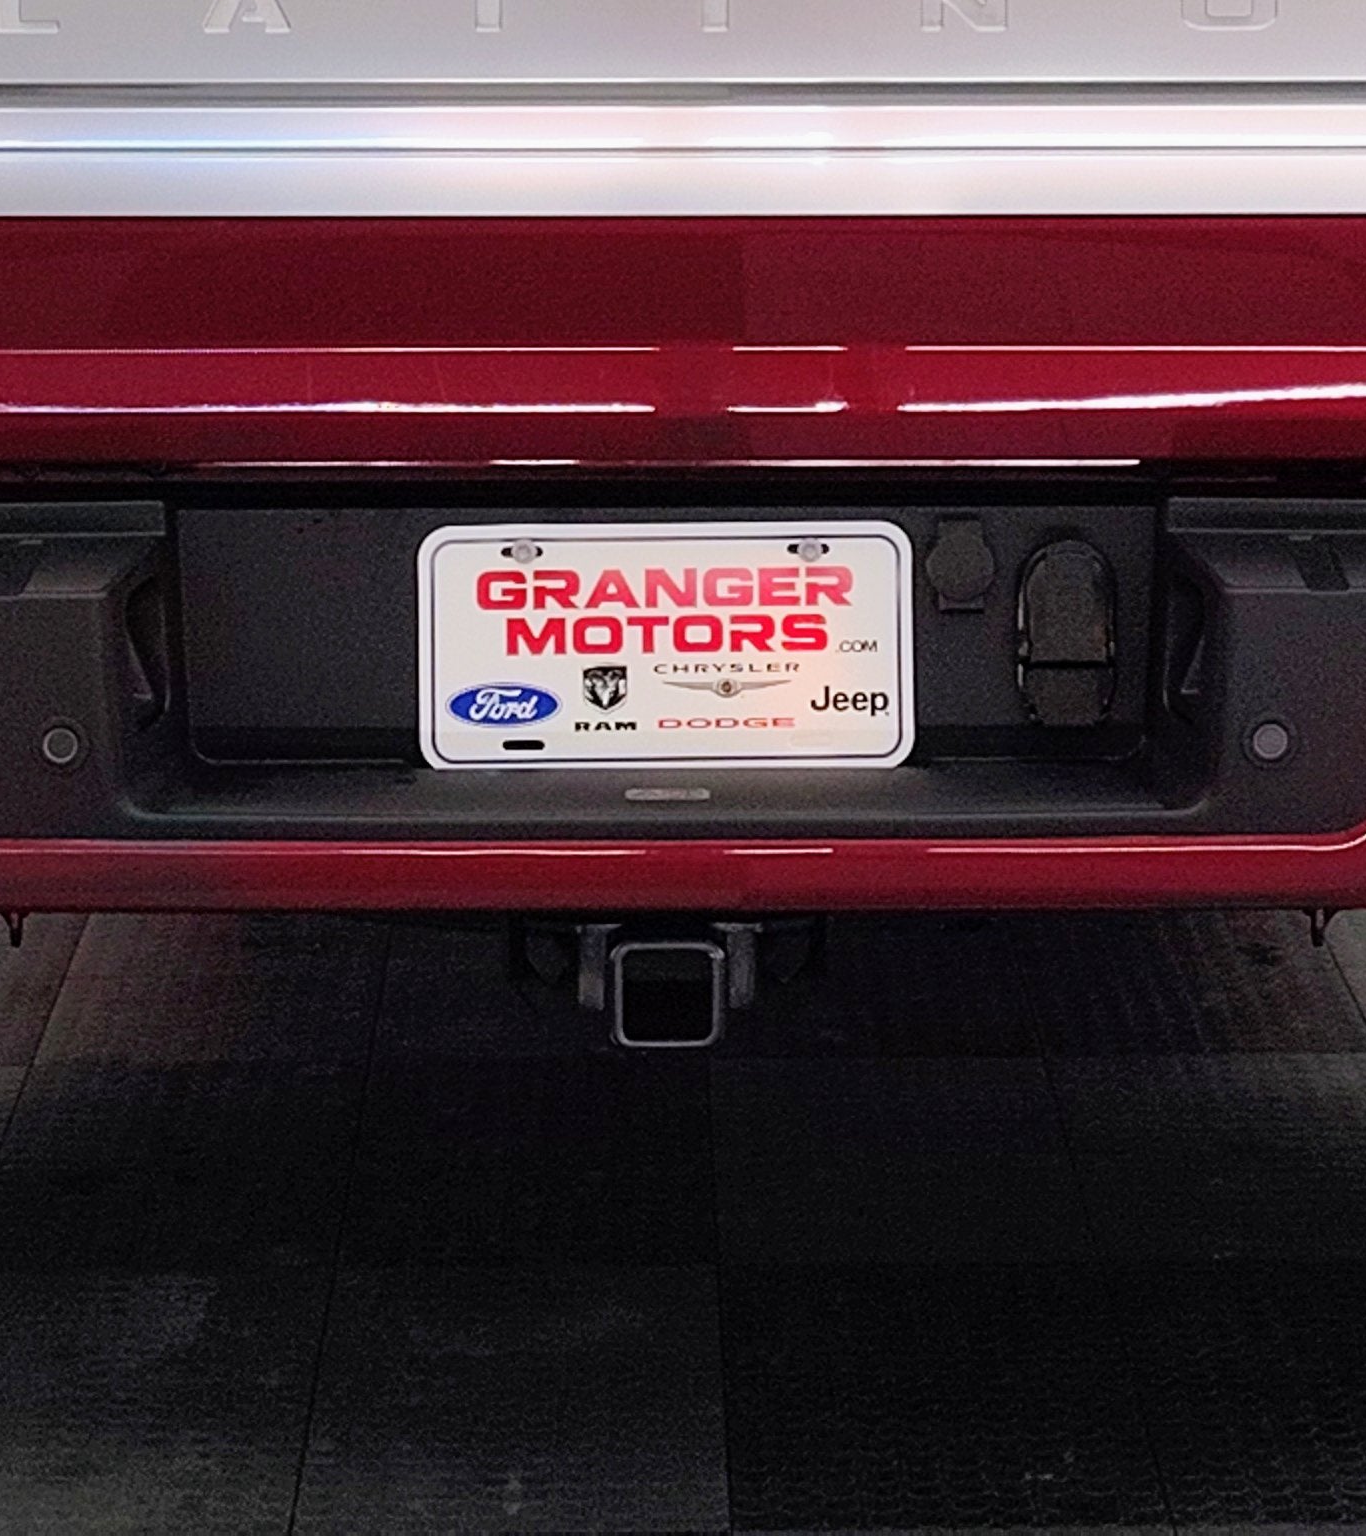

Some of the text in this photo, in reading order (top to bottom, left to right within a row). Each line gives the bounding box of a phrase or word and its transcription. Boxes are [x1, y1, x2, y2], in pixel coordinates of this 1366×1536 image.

[476, 566, 853, 610] GRANGER
[505, 614, 878, 656] MOTORS .COM
[653, 663, 801, 674] CHRYSLER
[468, 688, 539, 721] Ford
[810, 685, 889, 716] Jeep
[574, 721, 638, 732] RAM
[657, 717, 796, 729] DODGE
